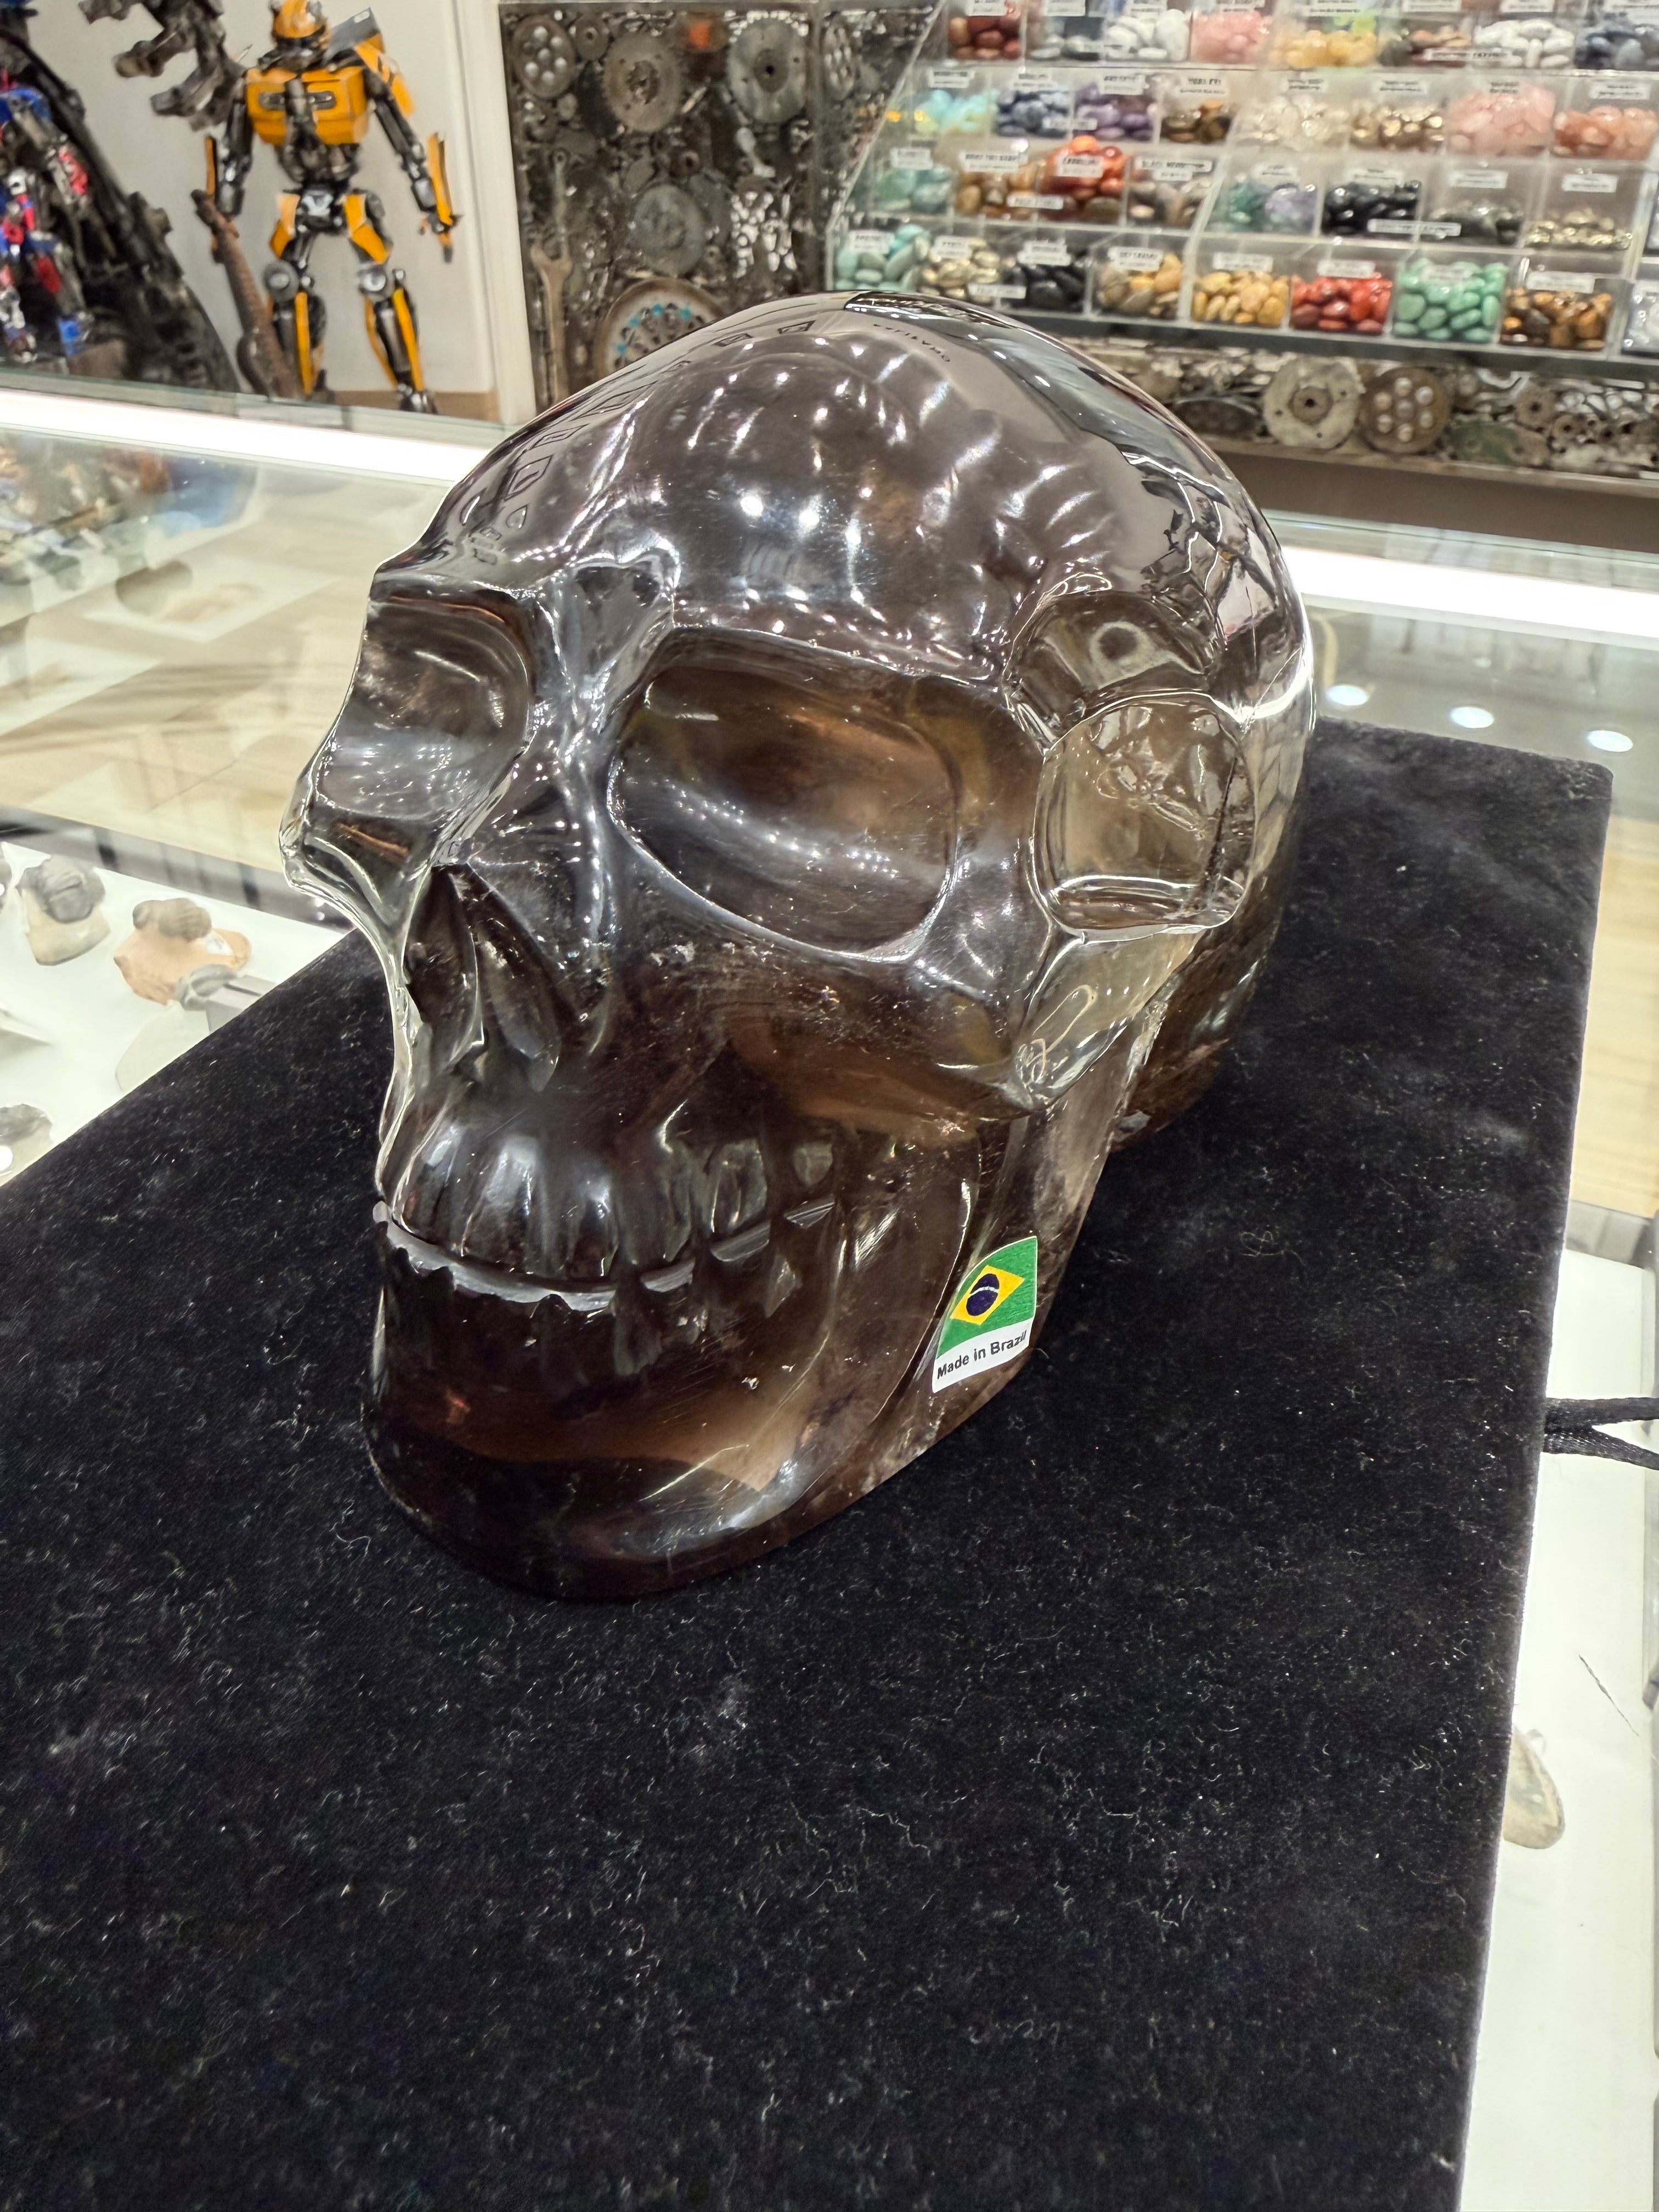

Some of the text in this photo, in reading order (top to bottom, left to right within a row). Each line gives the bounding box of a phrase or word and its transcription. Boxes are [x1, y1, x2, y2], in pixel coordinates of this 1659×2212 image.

[937, 1330, 1027, 1379] Made in Brazil
